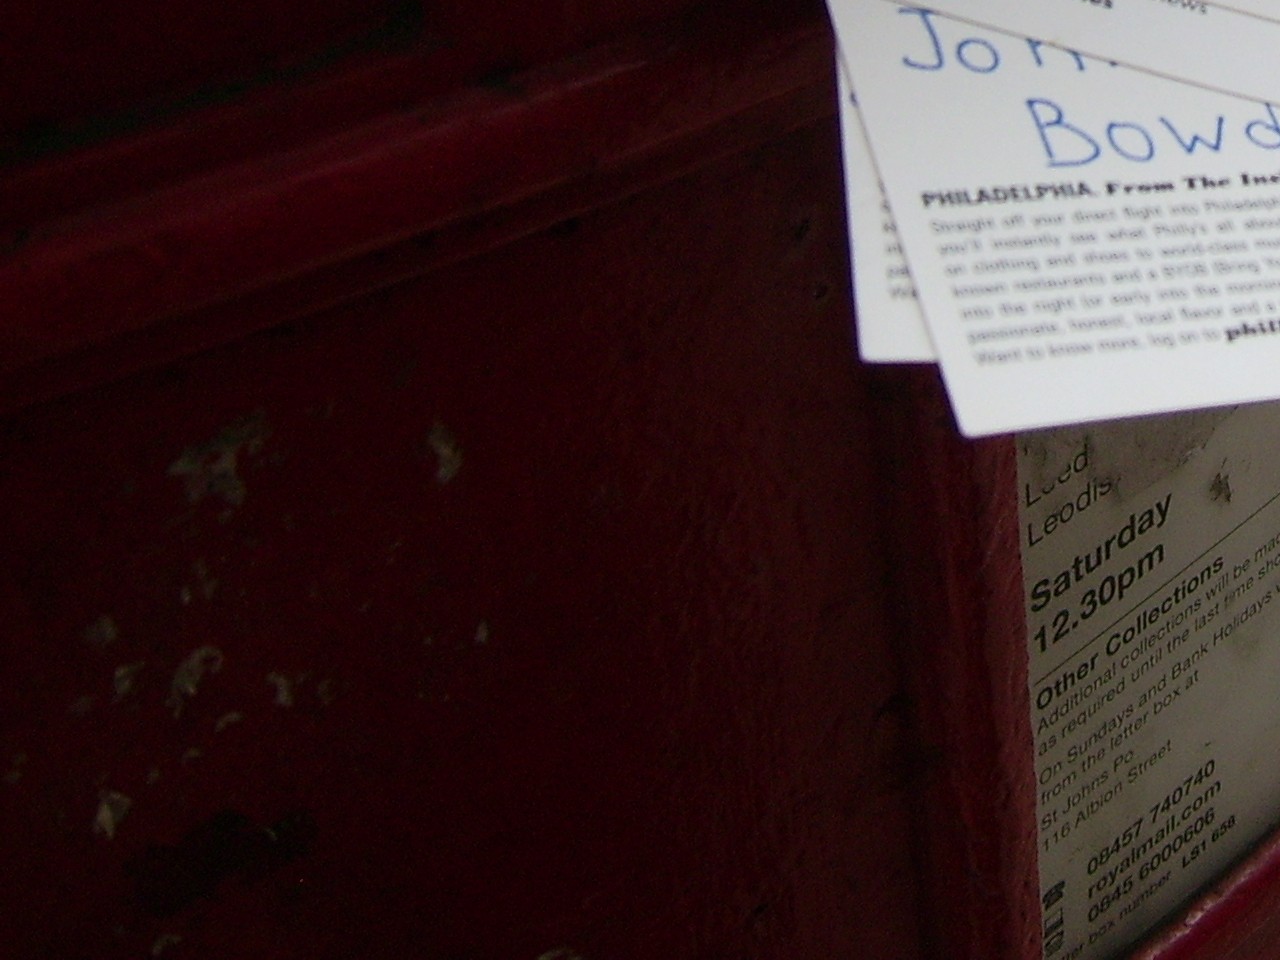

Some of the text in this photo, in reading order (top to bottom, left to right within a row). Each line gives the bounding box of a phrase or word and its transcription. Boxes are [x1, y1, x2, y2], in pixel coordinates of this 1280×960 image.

[1105, 179, 1175, 197] From
[1183, 175, 1231, 191] The
[1031, 493, 1172, 613] Saturday
[1034, 544, 1165, 653] 12.30pm
[1036, 556, 1224, 710] Other Collections
[1037, 662, 1116, 734] Additional
[1120, 598, 1201, 670] collections
[1205, 573, 1229, 602] will
[1233, 556, 1251, 581] be
[1038, 739, 1057, 757] as
[1061, 679, 1125, 740] required
[1131, 650, 1163, 682] until
[1166, 629, 1190, 654] the
[1194, 602, 1220, 632] last
[1039, 760, 1063, 786] On
[1066, 705, 1134, 763] Sundays
[1138, 676, 1167, 709] and
[1171, 641, 1209, 681] Bank
[1212, 590, 1273, 648] Holidays
[1041, 669, 1200, 806] from the letter box at
[1043, 738, 1172, 852] 116 Albion Street
[1041, 809, 1058, 832] St
[1062, 770, 1109, 815] Johns
[1087, 759, 1216, 876] 08457 740740
[1087, 780, 1221, 900] royalmail.com
[1181, 840, 1208, 869] LS1
[1087, 806, 1216, 923] 0845 6000606
